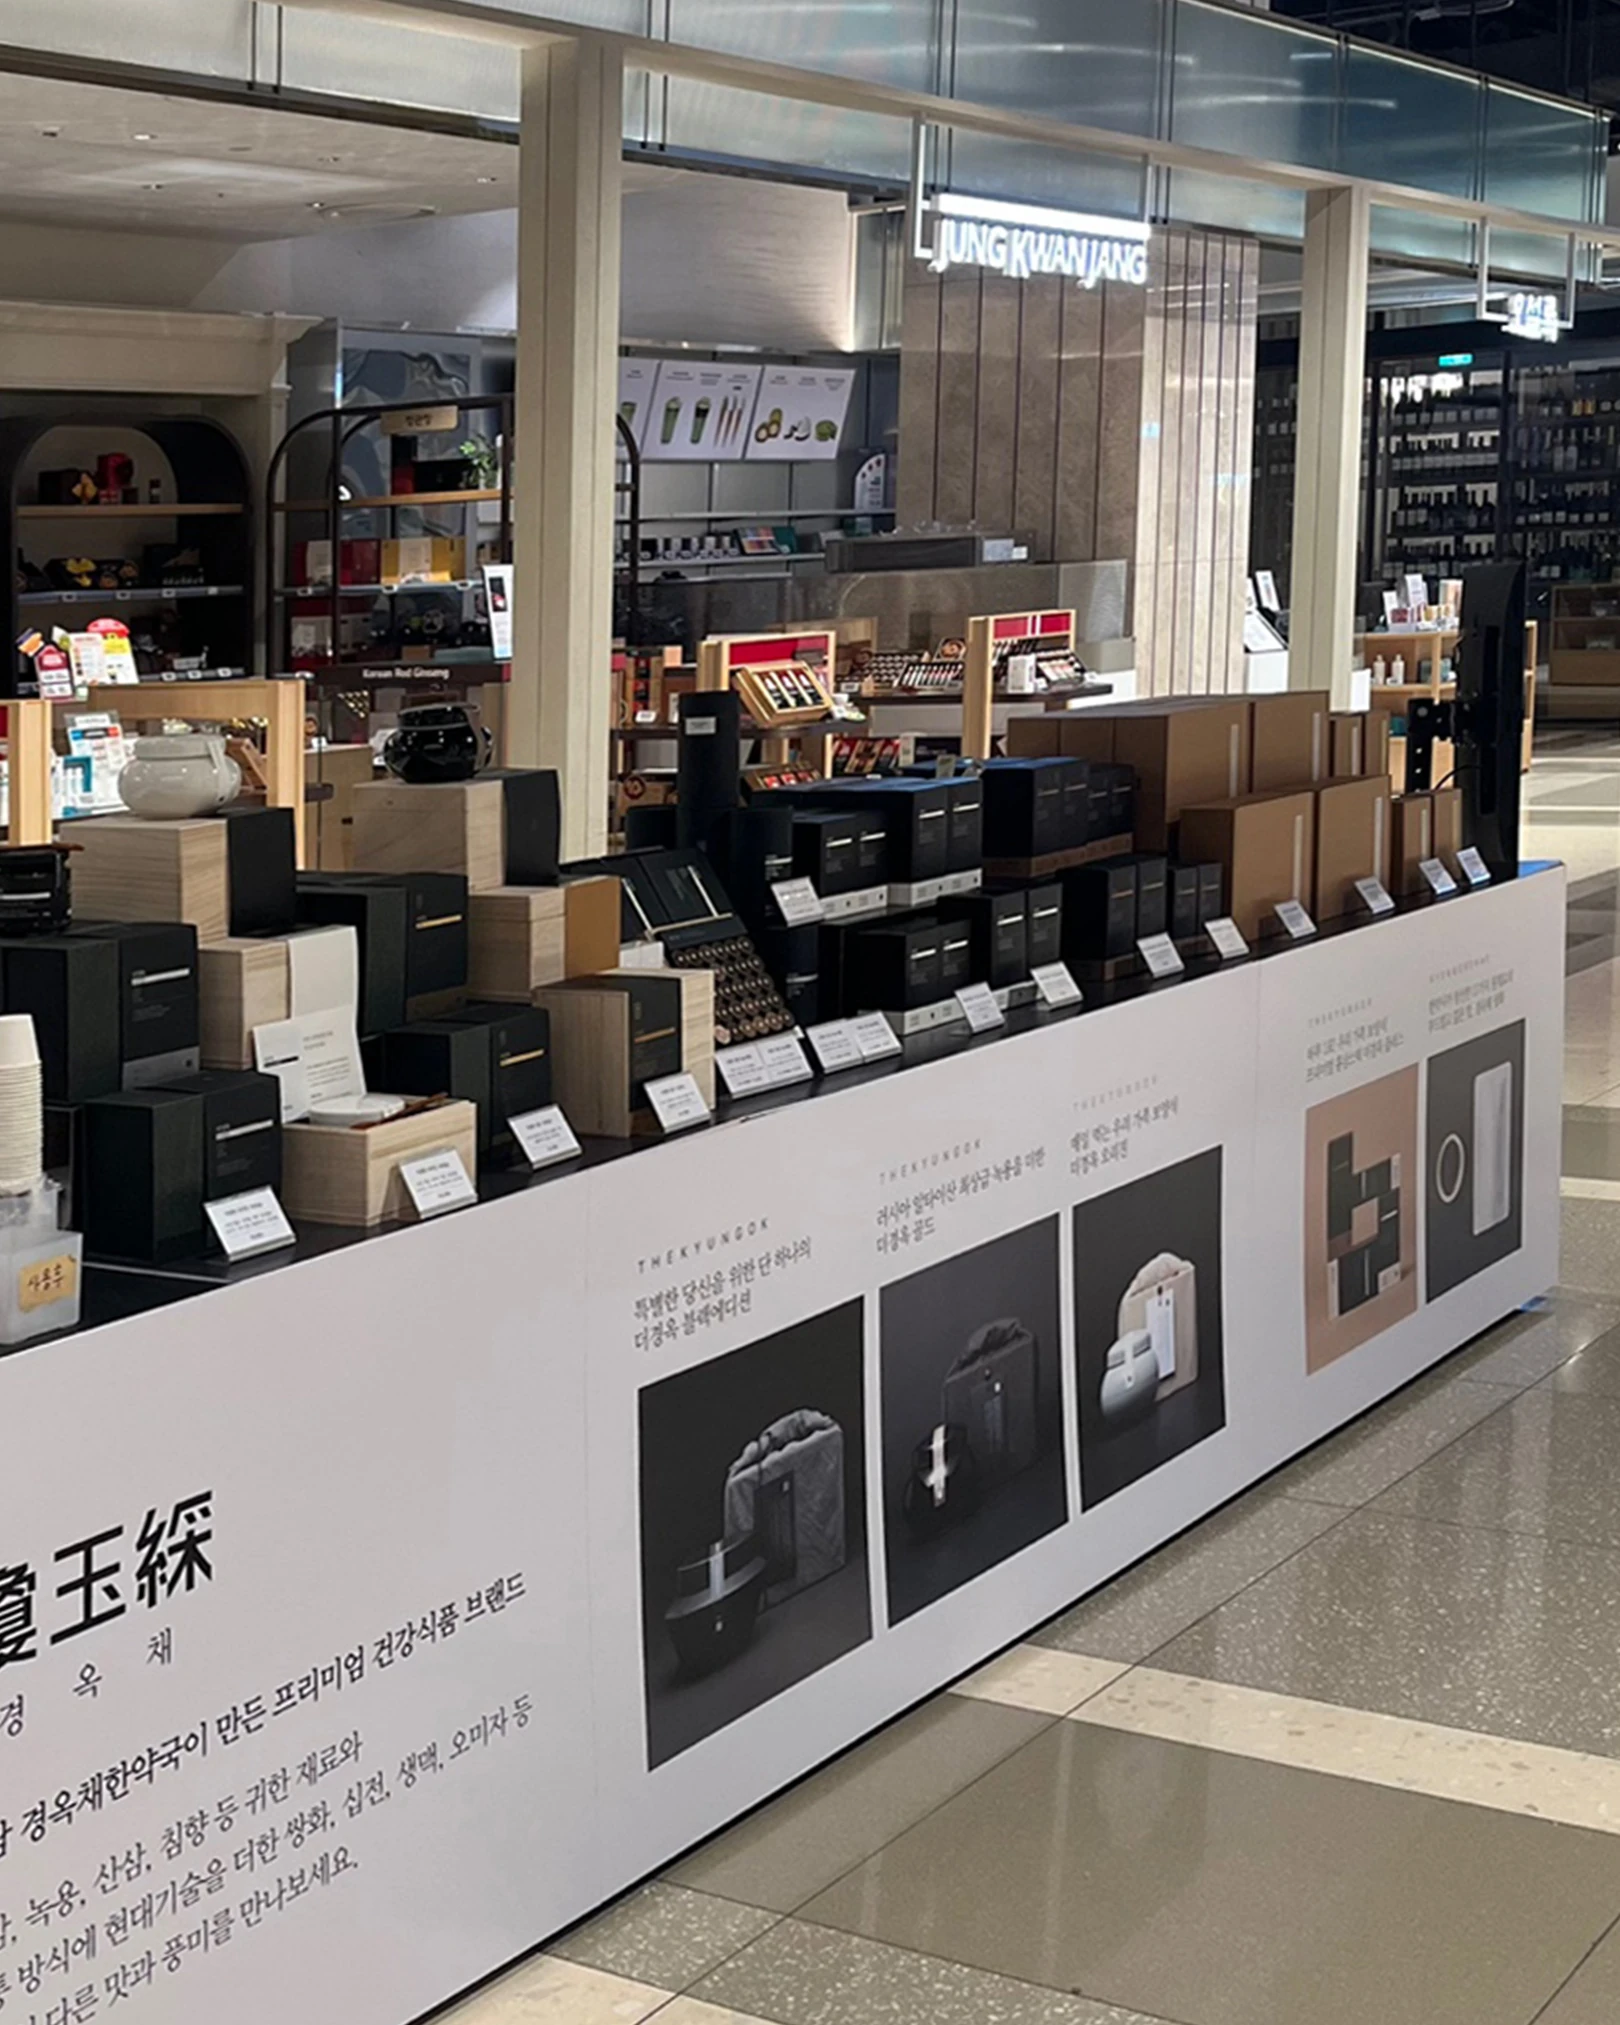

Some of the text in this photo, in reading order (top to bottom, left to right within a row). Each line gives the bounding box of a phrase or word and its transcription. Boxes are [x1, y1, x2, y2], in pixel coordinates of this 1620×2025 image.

[928, 219, 1147, 289] JUNGKWANJANG
[362, 666, 450, 680] Korean Red Ginseng
[638, 1217, 768, 1274] THEKYUNGOK
[876, 1198, 911, 1226] 러시아
[876, 1224, 910, 1254] 더경옥
[634, 1236, 811, 1321] 특별한 당신을 위한 단 하나의
[634, 1288, 751, 1351] 더경옥 블랙에디션
[73, 1663, 102, 1698] 옥
[147, 1627, 171, 1665] 채
[20, 1721, 208, 1843] 경옥채한약국이
[216, 1695, 267, 1745] 만든
[272, 1645, 365, 1716] 프리미엄
[372, 1602, 459, 1668] 건강식품
[464, 1572, 526, 1623] 브랜드
[161, 1809, 210, 1860] 침향
[213, 1795, 239, 1832] 등
[245, 1767, 291, 1815] 귀한
[295, 1730, 363, 1786] 재료와
[17, 1923, 96, 1993] 방식에
[104, 1857, 227, 1947] 현대기술을
[233, 1827, 279, 1873] 더한
[449, 1706, 509, 1760] 오미자
[512, 1694, 532, 1728] 등
[104, 1950, 157, 2008] 맛과
[160, 1908, 236, 1973] 풍미를
[240, 1846, 358, 1928] 만나보세요.
